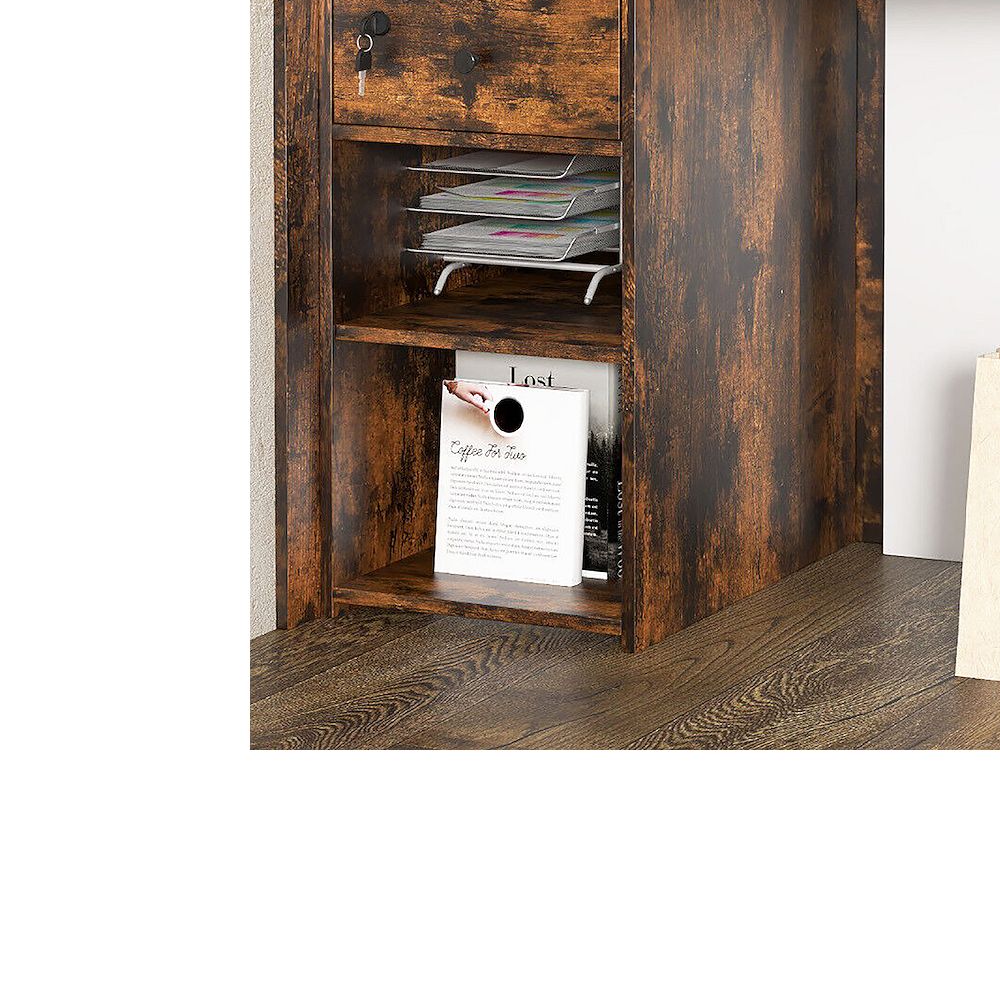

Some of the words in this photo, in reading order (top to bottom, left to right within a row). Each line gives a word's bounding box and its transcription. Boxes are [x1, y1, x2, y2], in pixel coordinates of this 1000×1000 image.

[508, 366, 555, 388] Lost
[450, 440, 483, 463] Coffee
[485, 443, 502, 459] For
[503, 445, 527, 460] Two
